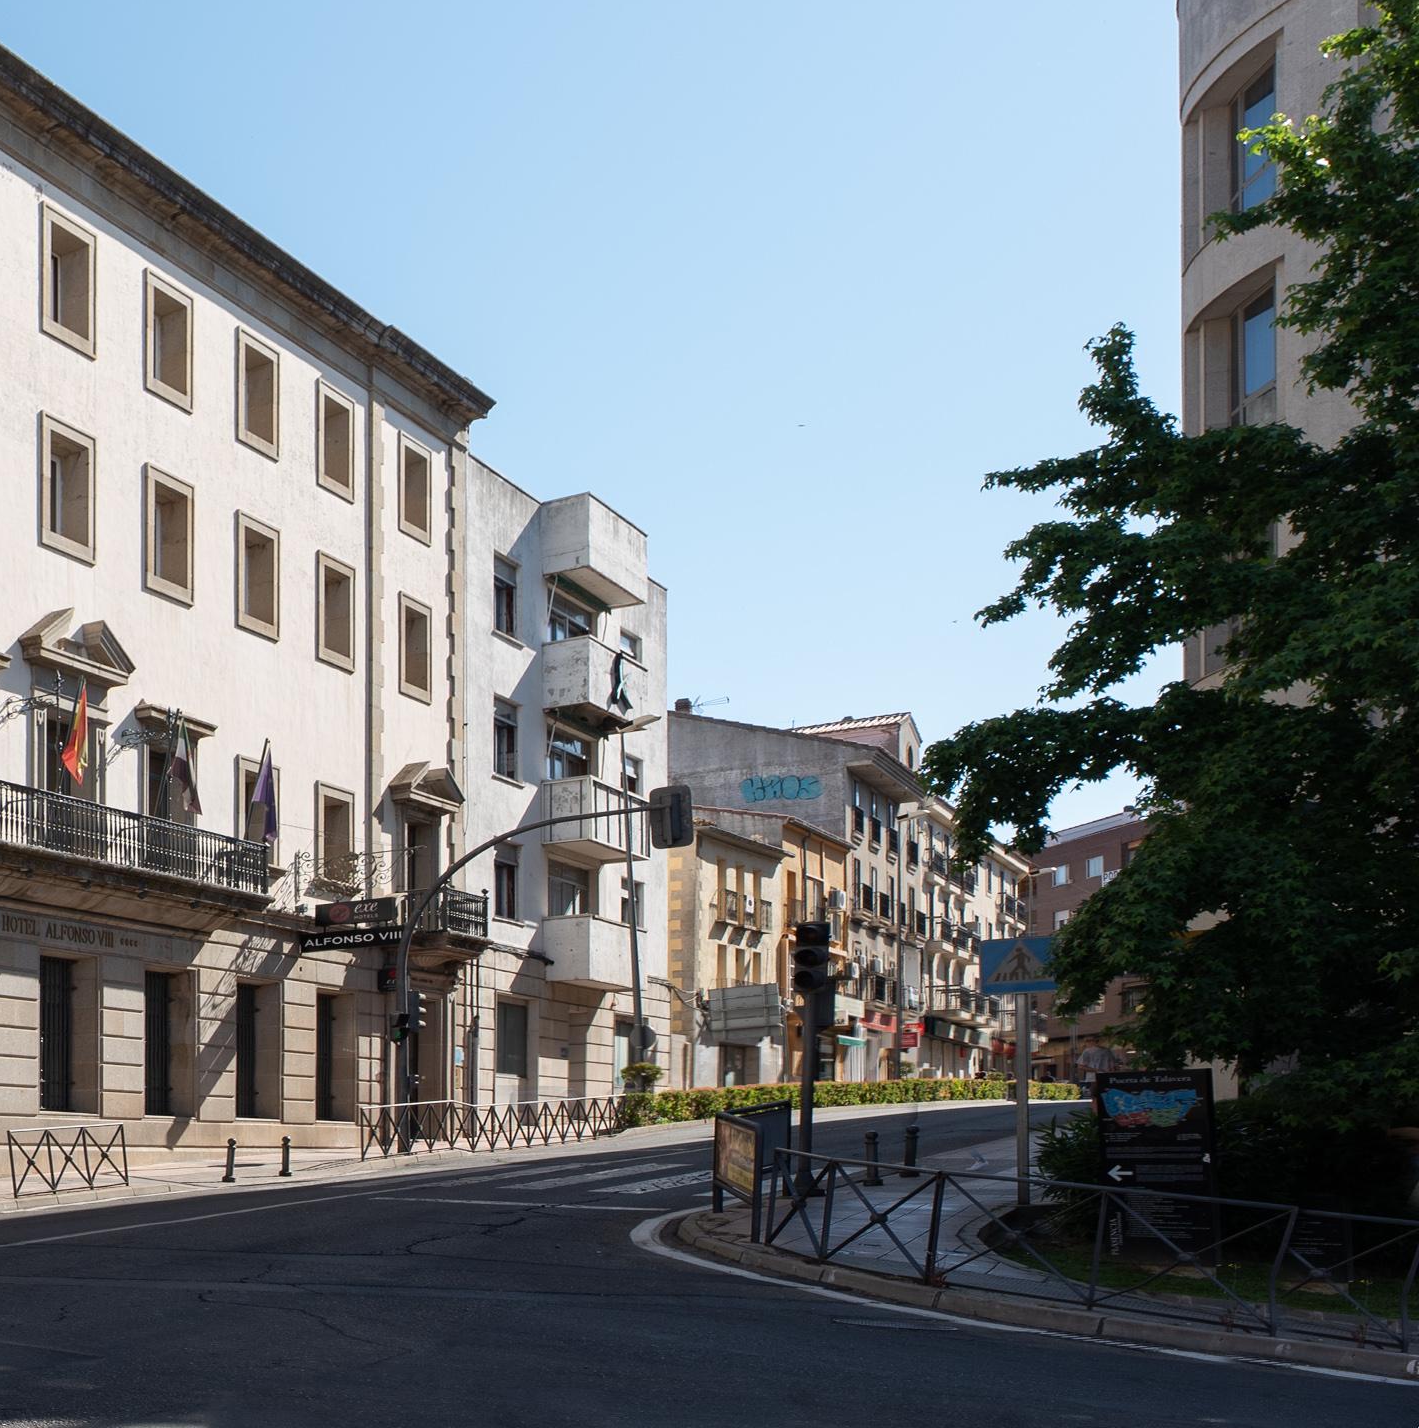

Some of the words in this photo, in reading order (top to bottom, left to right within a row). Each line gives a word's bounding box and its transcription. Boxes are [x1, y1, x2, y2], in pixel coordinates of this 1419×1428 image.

[354, 901, 378, 914] exe
[354, 912, 379, 920] HOTELS
[1, 915, 40, 937] HOTEL
[45, 922, 96, 945] ALFONSO
[97, 929, 114, 948] VIII
[304, 933, 374, 947] ALFONSO
[379, 930, 402, 941] VIII
[1109, 1076, 1138, 1084] Puerta
[1154, 1075, 1192, 1083] Talavera
